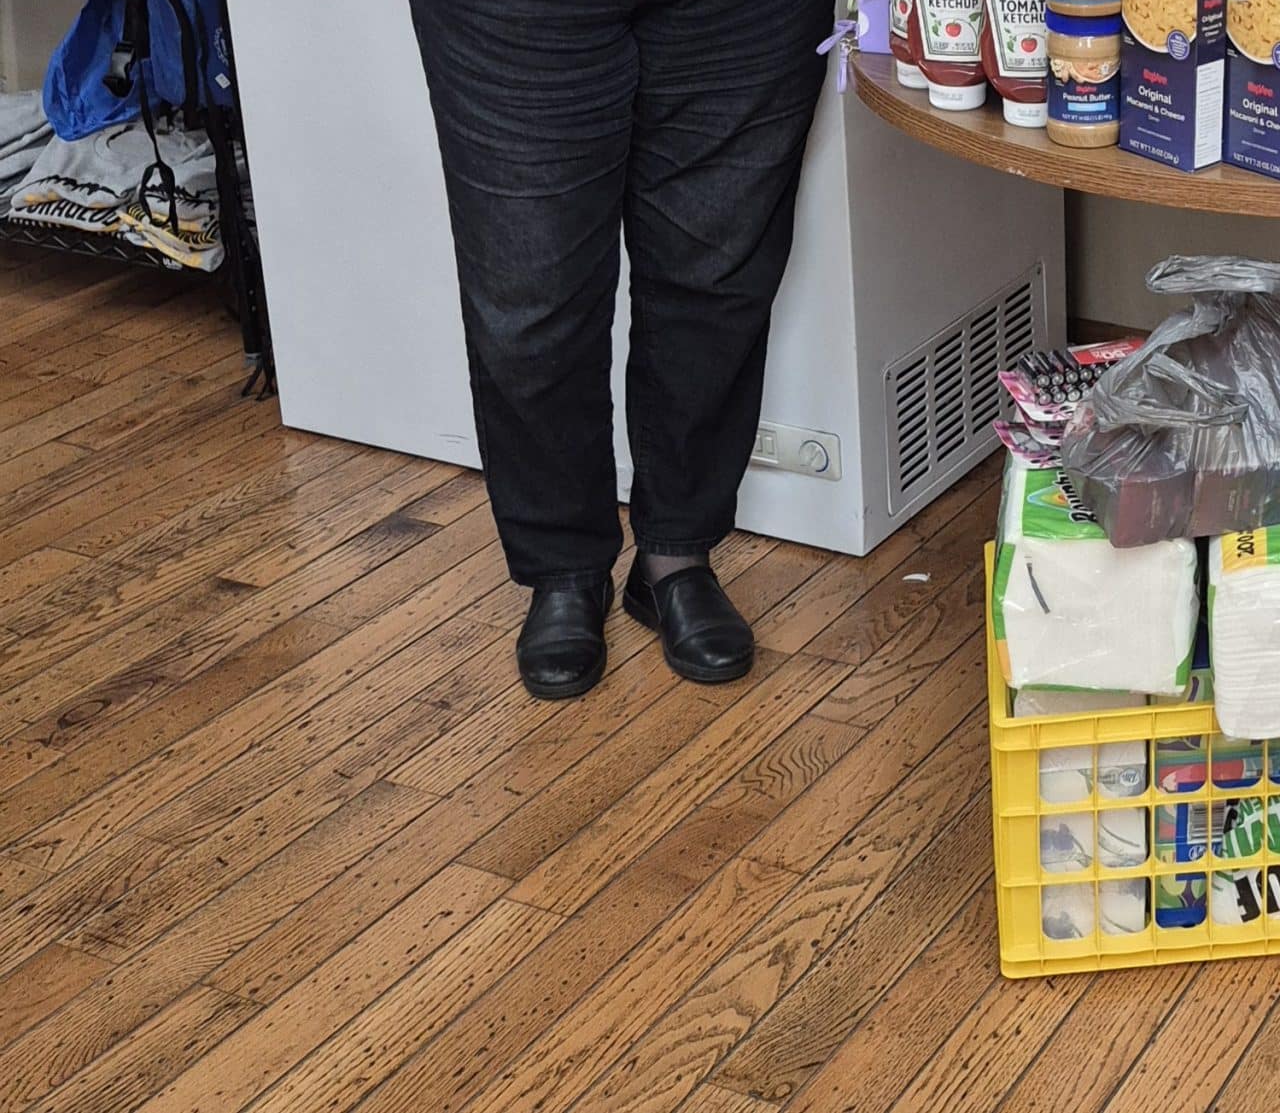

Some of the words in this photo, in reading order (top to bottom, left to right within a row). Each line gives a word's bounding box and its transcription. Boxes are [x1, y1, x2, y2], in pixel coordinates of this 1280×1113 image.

[999, 0, 1046, 12] TOMAT
[1003, 13, 1046, 25] KETCHU
[1062, 91, 1087, 101] Peanut
[1088, 92, 1111, 102] Butter
[1138, 85, 1172, 105] Original
[1127, 95, 1154, 112] Macaroni
[1154, 105, 1160, 115] &
[1160, 108, 1186, 122] Cheese
[1230, 108, 1258, 125] Macaroni
[1259, 117, 1265, 127] &
[1242, 98, 1278, 118] Original
